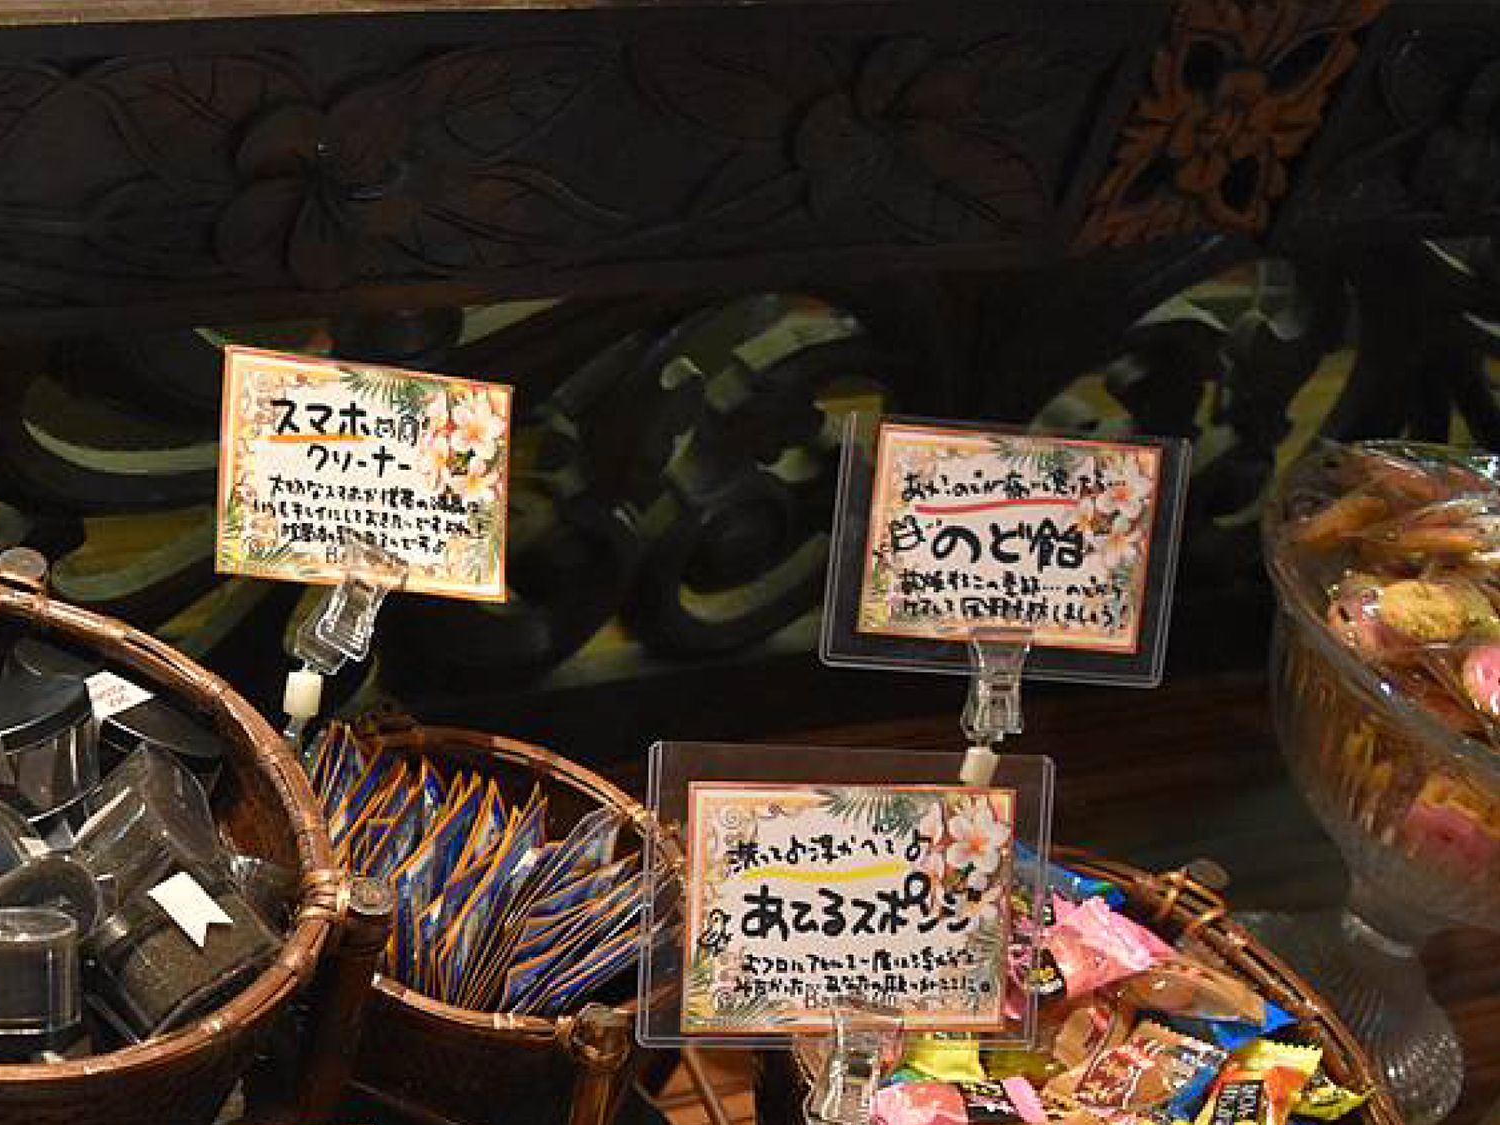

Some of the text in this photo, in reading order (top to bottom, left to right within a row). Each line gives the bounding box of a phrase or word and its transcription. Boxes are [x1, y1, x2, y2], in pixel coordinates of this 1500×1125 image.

[306, 445, 412, 478] クリーナー
[931, 517, 1086, 573] のど飴
